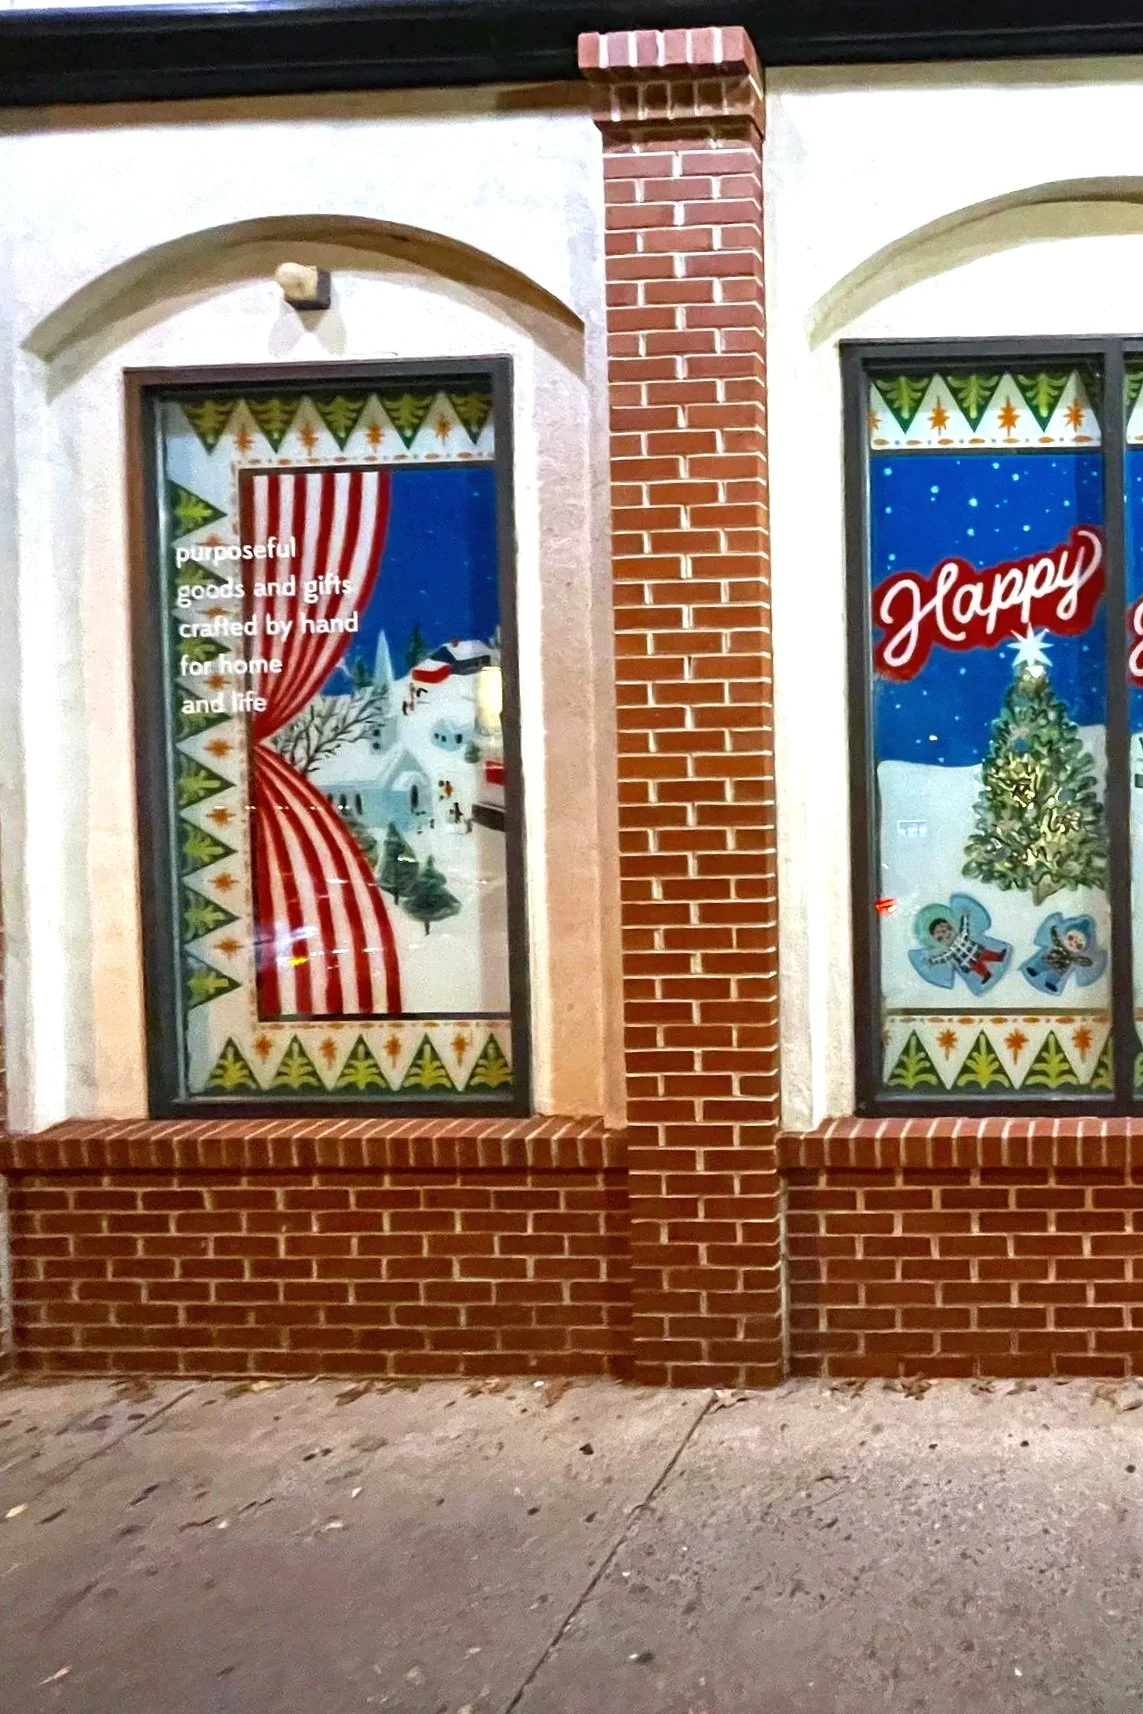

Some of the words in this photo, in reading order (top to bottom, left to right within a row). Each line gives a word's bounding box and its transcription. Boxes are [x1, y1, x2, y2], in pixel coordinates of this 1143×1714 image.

[175, 536, 297, 568] purposeful
[176, 575, 246, 608] goods
[253, 574, 297, 598] and
[303, 572, 353, 604] gifts
[880, 529, 1102, 668] Happy
[178, 614, 258, 638] crafted
[265, 613, 293, 642] by
[301, 611, 359, 634] hand
[180, 654, 212, 677] for
[219, 653, 283, 675] home
[181, 692, 224, 715] and
[232, 690, 268, 713] life
